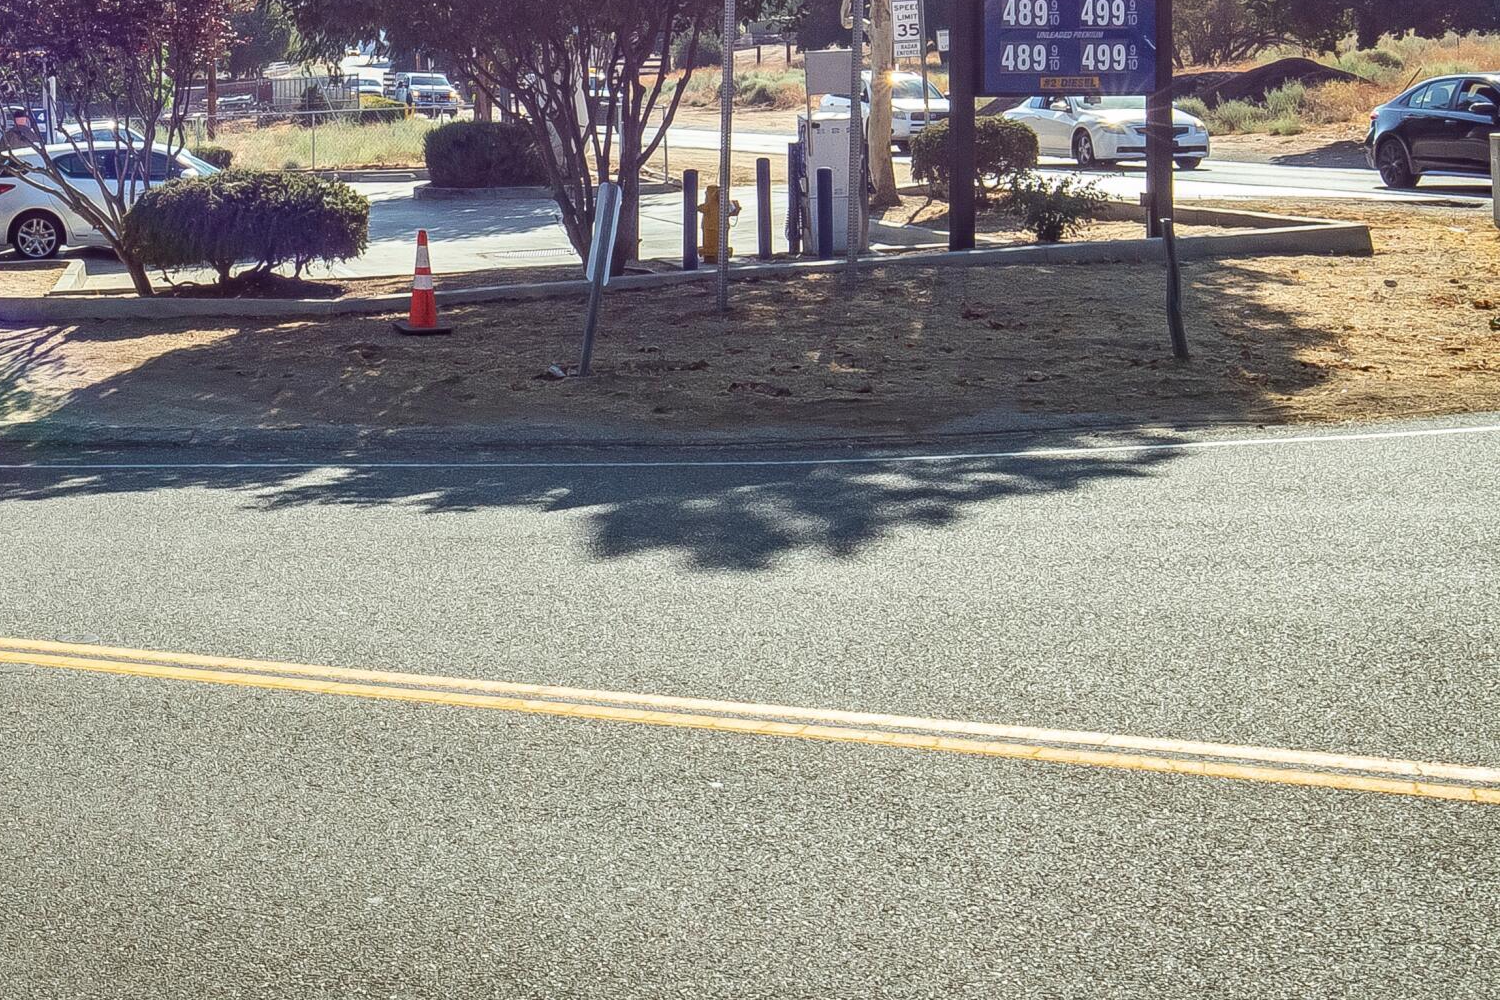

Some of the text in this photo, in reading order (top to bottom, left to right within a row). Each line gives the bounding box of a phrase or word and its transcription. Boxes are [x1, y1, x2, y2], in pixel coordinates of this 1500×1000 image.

[1003, 0, 1048, 26] 489
[1081, 0, 1125, 26] 499
[898, 23, 920, 37] 35
[1036, 31, 1072, 39] UNLEADED
[1001, 44, 1047, 71] 489
[1082, 44, 1126, 71] 499
[1061, 78, 1097, 88] DIESEL
[37, 112, 45, 121] 4
